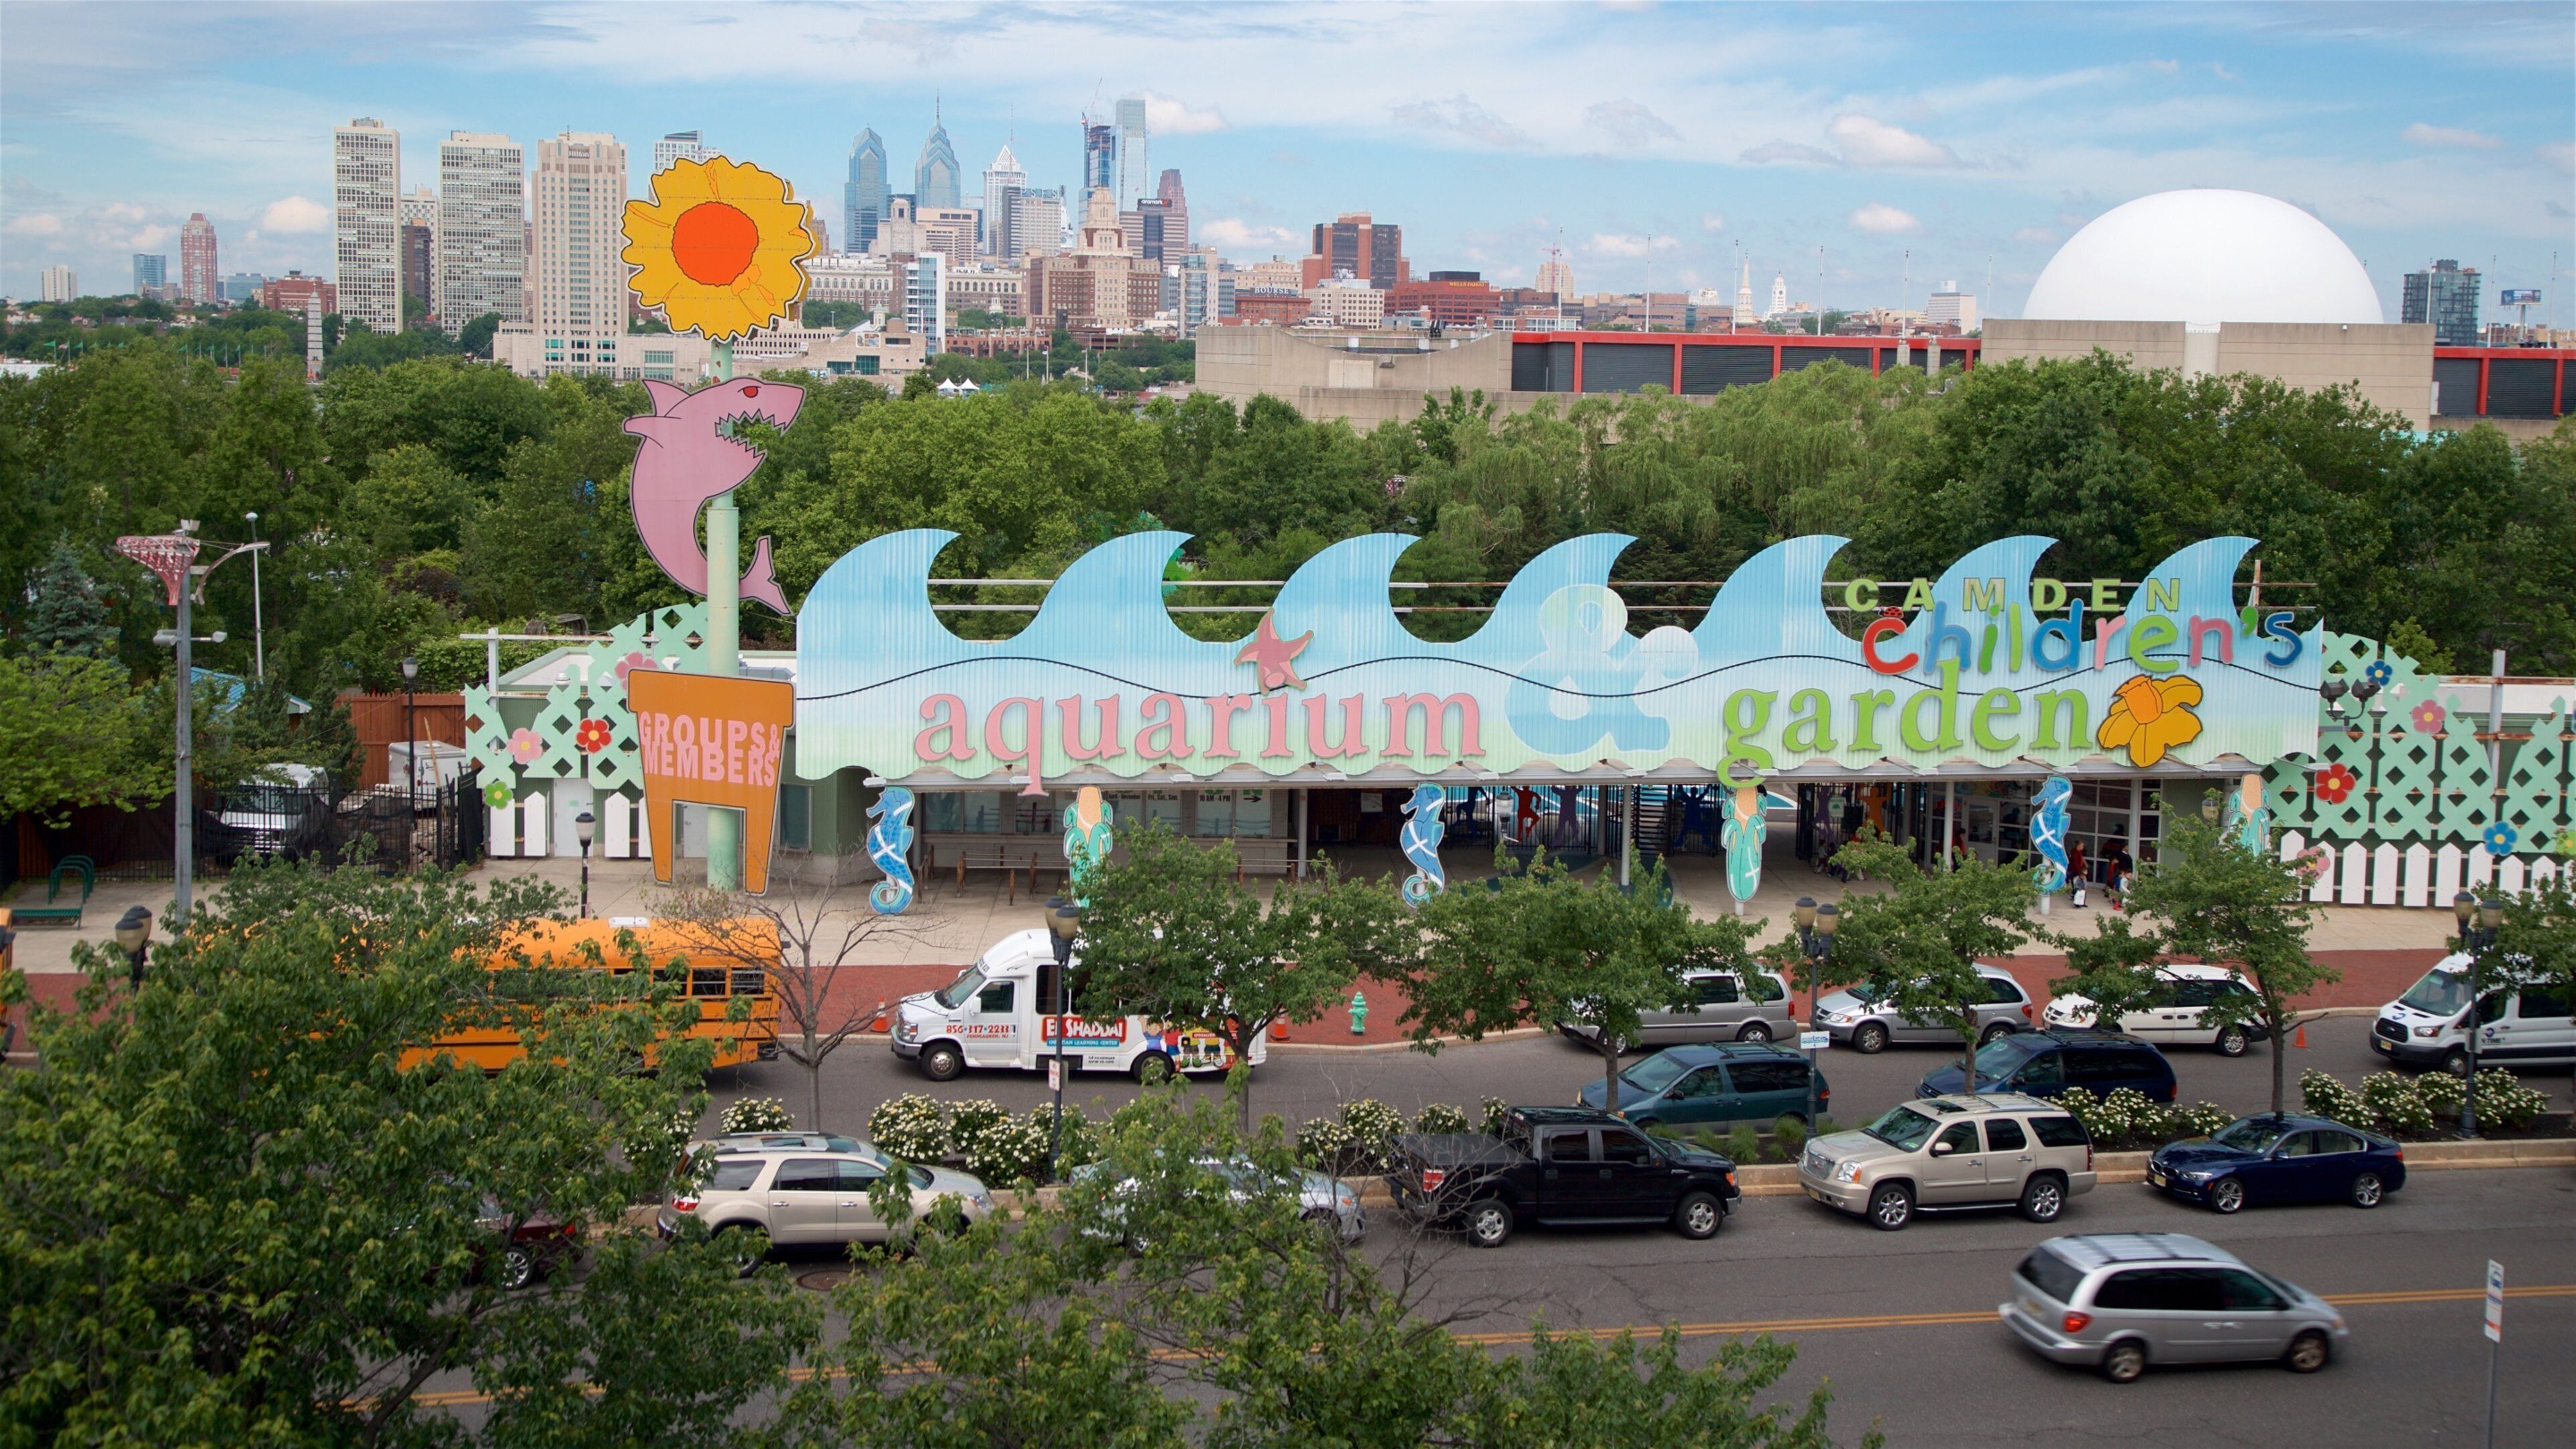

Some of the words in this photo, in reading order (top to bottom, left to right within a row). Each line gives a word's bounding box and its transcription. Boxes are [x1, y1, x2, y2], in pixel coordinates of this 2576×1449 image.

[1844, 577, 2182, 612] CAMDEN
[914, 691, 1486, 796] aquarium
[1505, 584, 1699, 756] &
[1715, 657, 2091, 789] garden
[643, 741, 776, 788] MEMBERS
